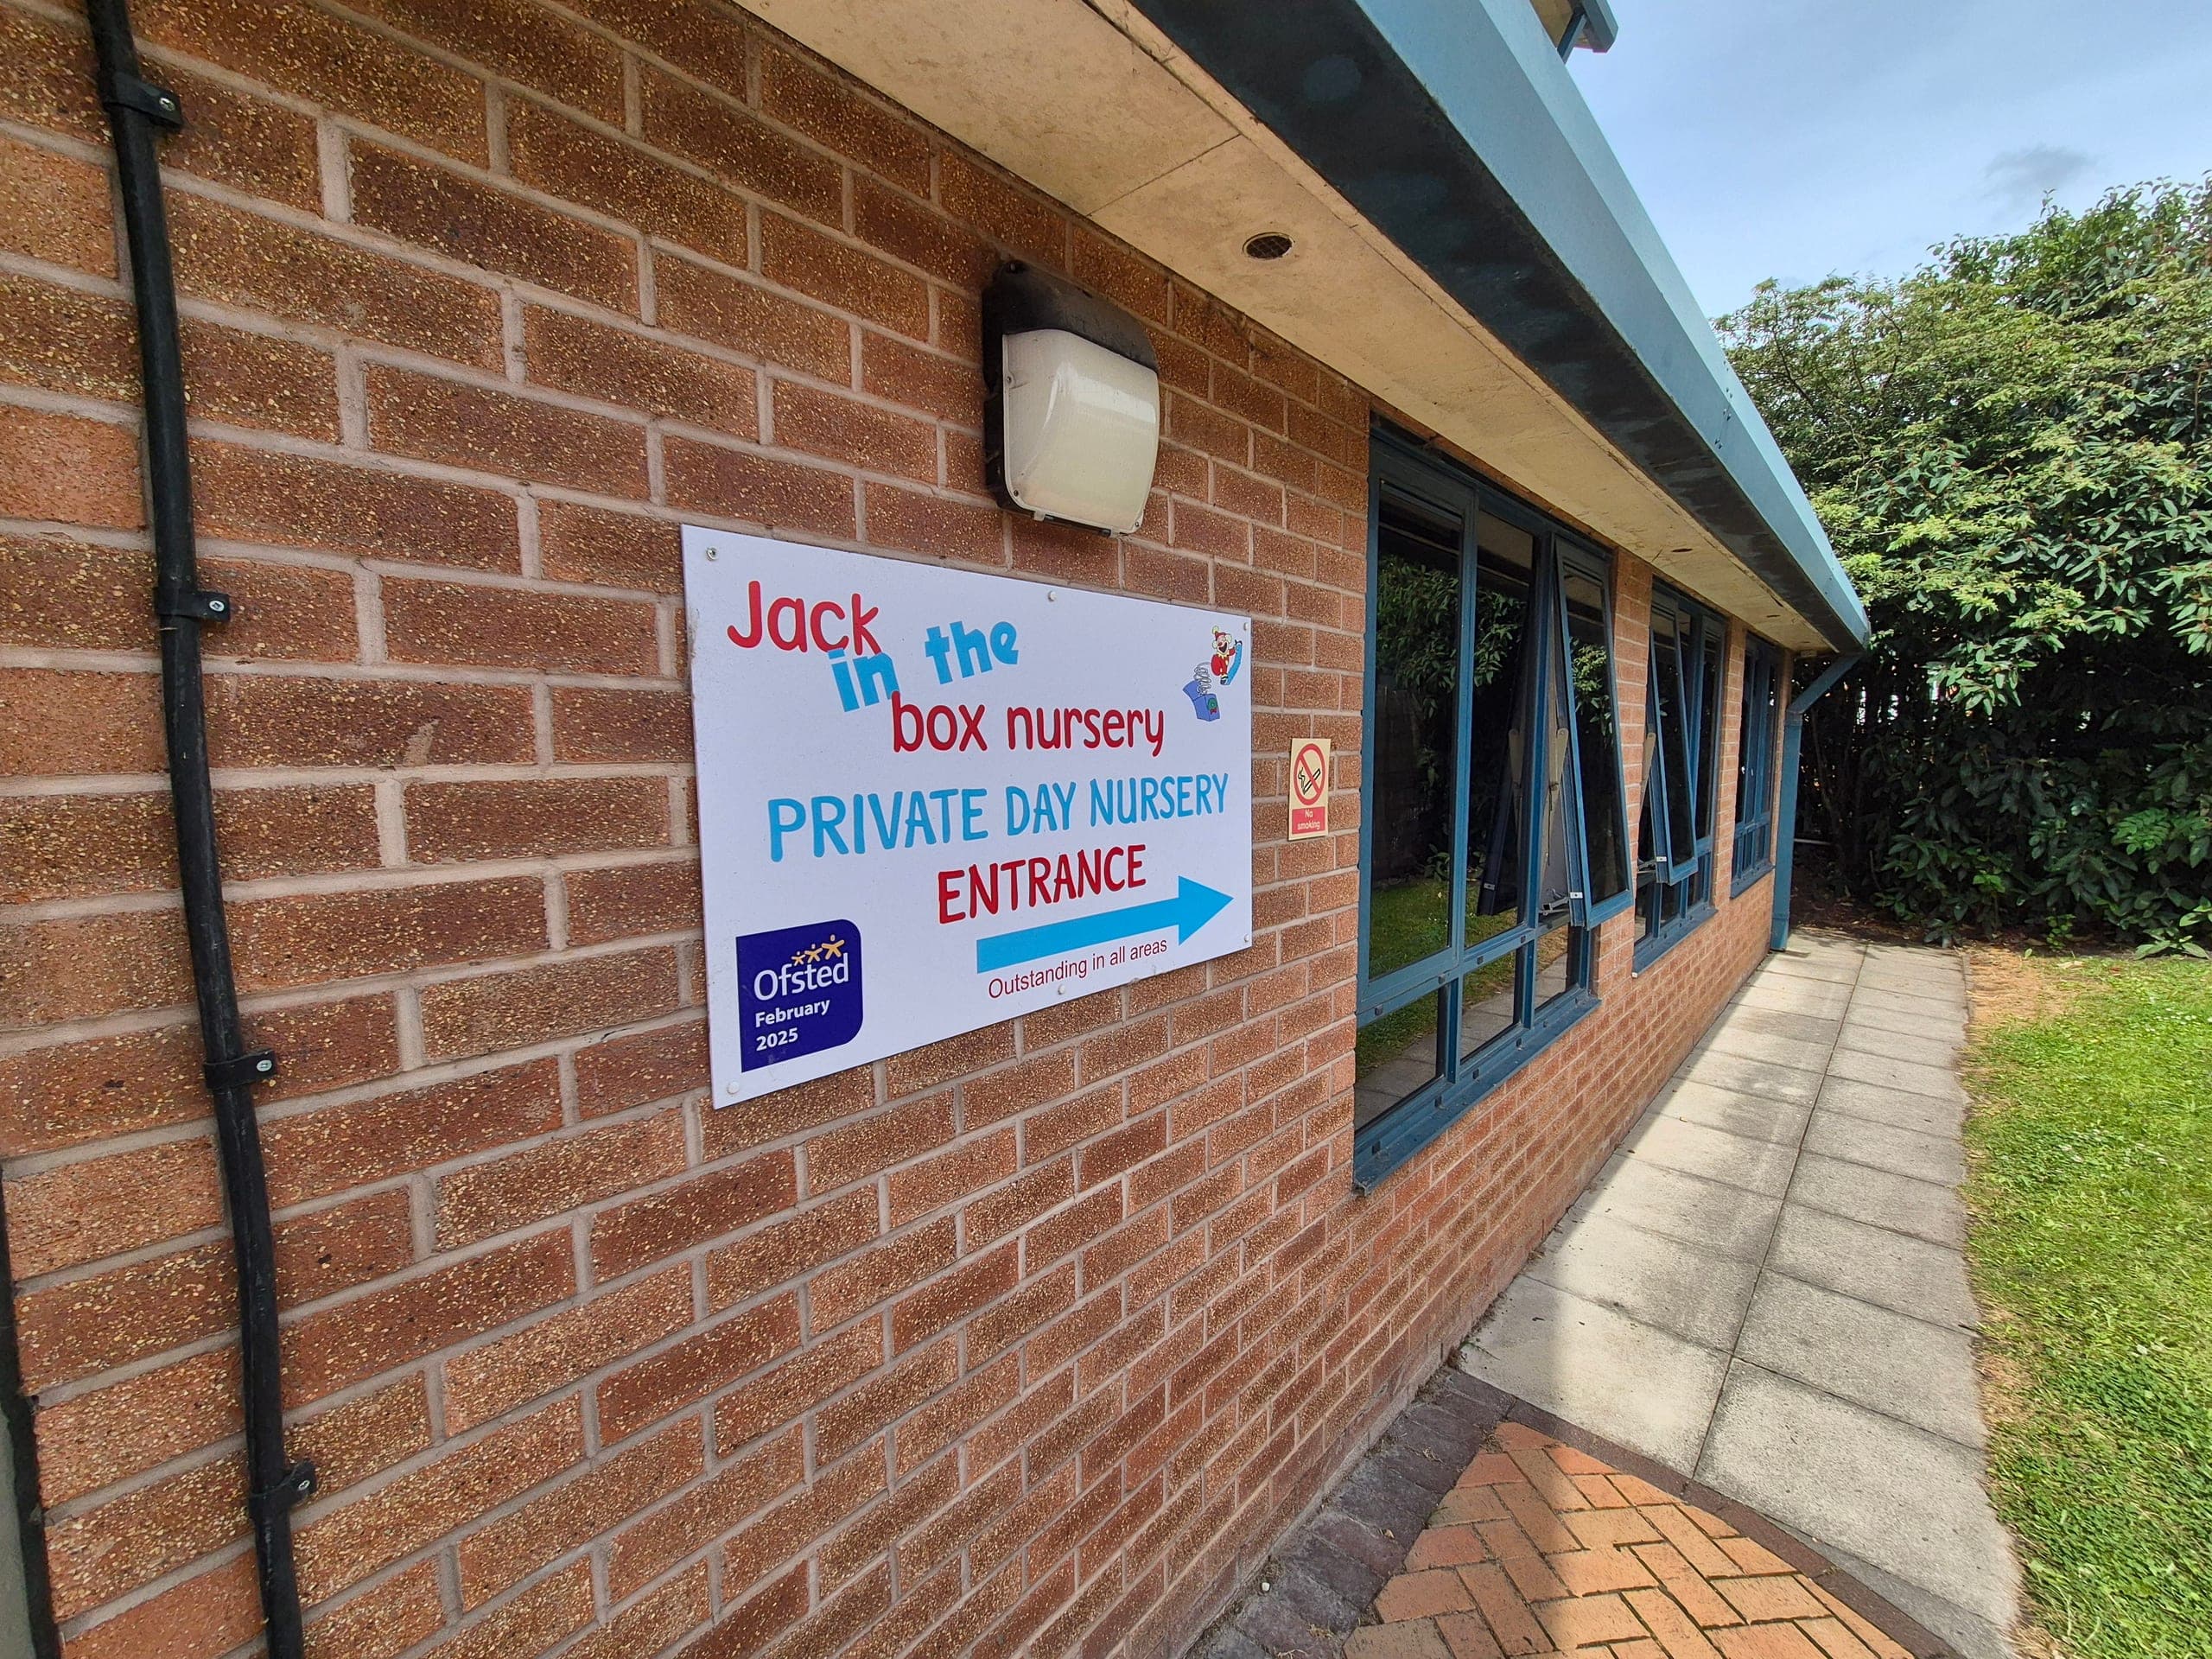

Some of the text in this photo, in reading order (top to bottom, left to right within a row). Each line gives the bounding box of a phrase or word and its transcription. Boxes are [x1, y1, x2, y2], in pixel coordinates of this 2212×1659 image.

[728, 581, 880, 656] Jack
[828, 620, 1019, 712] in the
[892, 691, 1164, 757] box nursery
[767, 773, 1229, 862] PRIVATE DAY NURSERY
[1297, 820, 1320, 830] smoking
[1305, 808, 1313, 818] No
[938, 844, 1147, 925] ENTRANCE
[753, 952, 849, 1001] Ofsted
[988, 939, 1167, 999] Outstanding in all areas
[755, 999, 830, 1027] February
[756, 1027, 798, 1052] 2025
